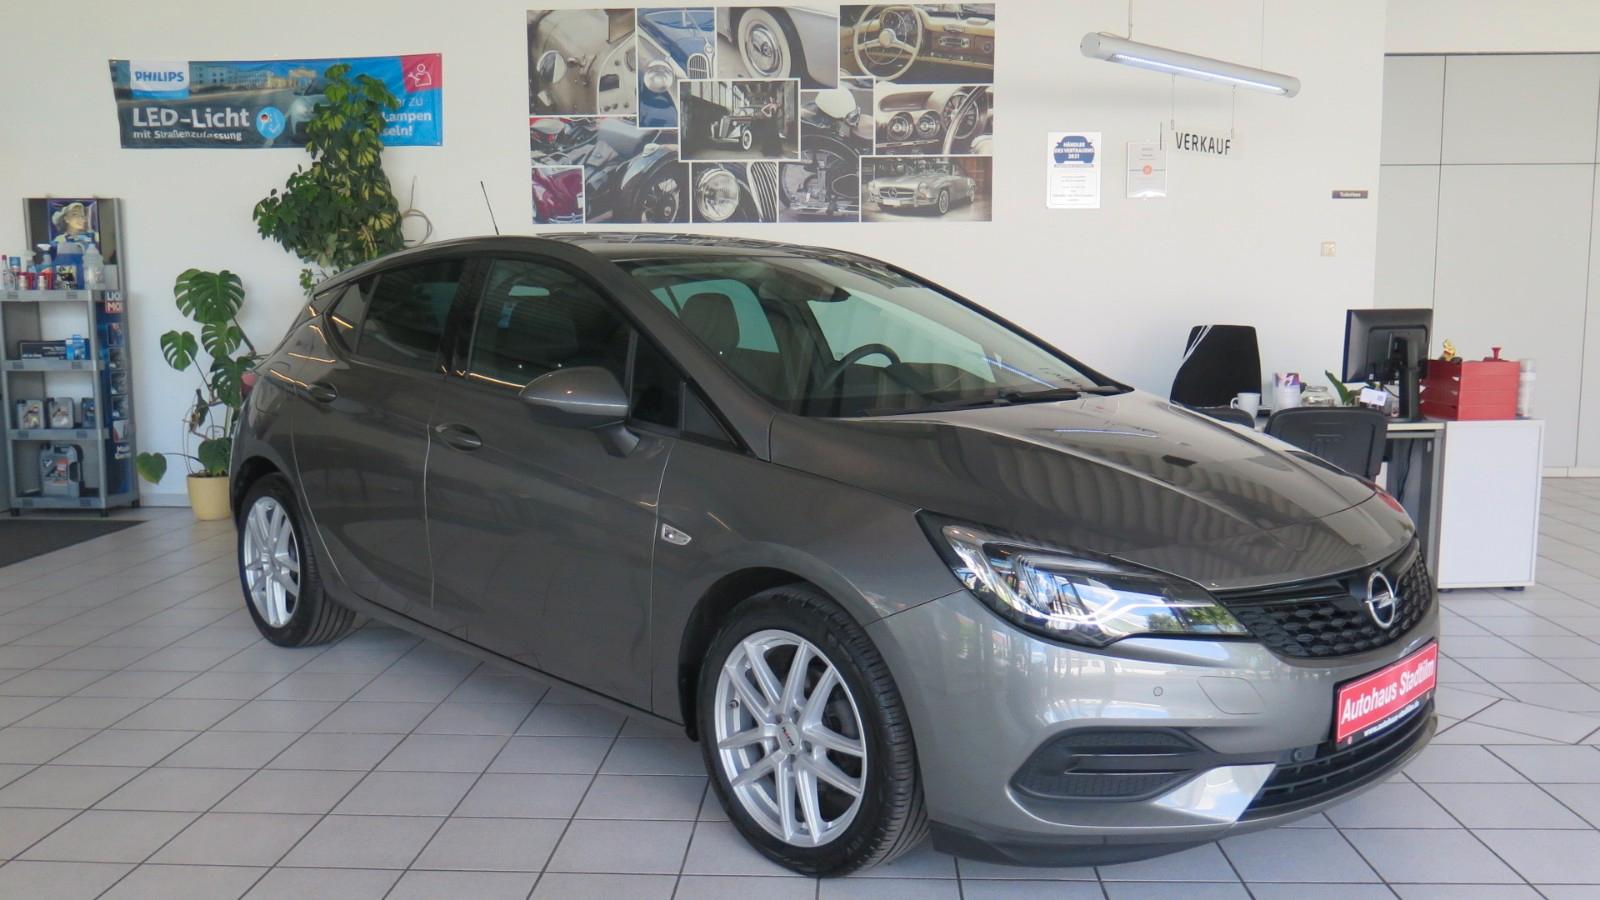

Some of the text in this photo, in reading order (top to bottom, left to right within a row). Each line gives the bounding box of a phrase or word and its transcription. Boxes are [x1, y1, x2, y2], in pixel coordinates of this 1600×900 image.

[135, 71, 184, 82] PHILIPS
[408, 97, 424, 107] zu
[133, 107, 250, 128] LED-Licht
[133, 130, 242, 141] mit Straßenzulassung
[381, 125, 413, 136] seln!
[1175, 132, 1231, 155] VERKAUF
[1340, 682, 1398, 725] Autohaus
